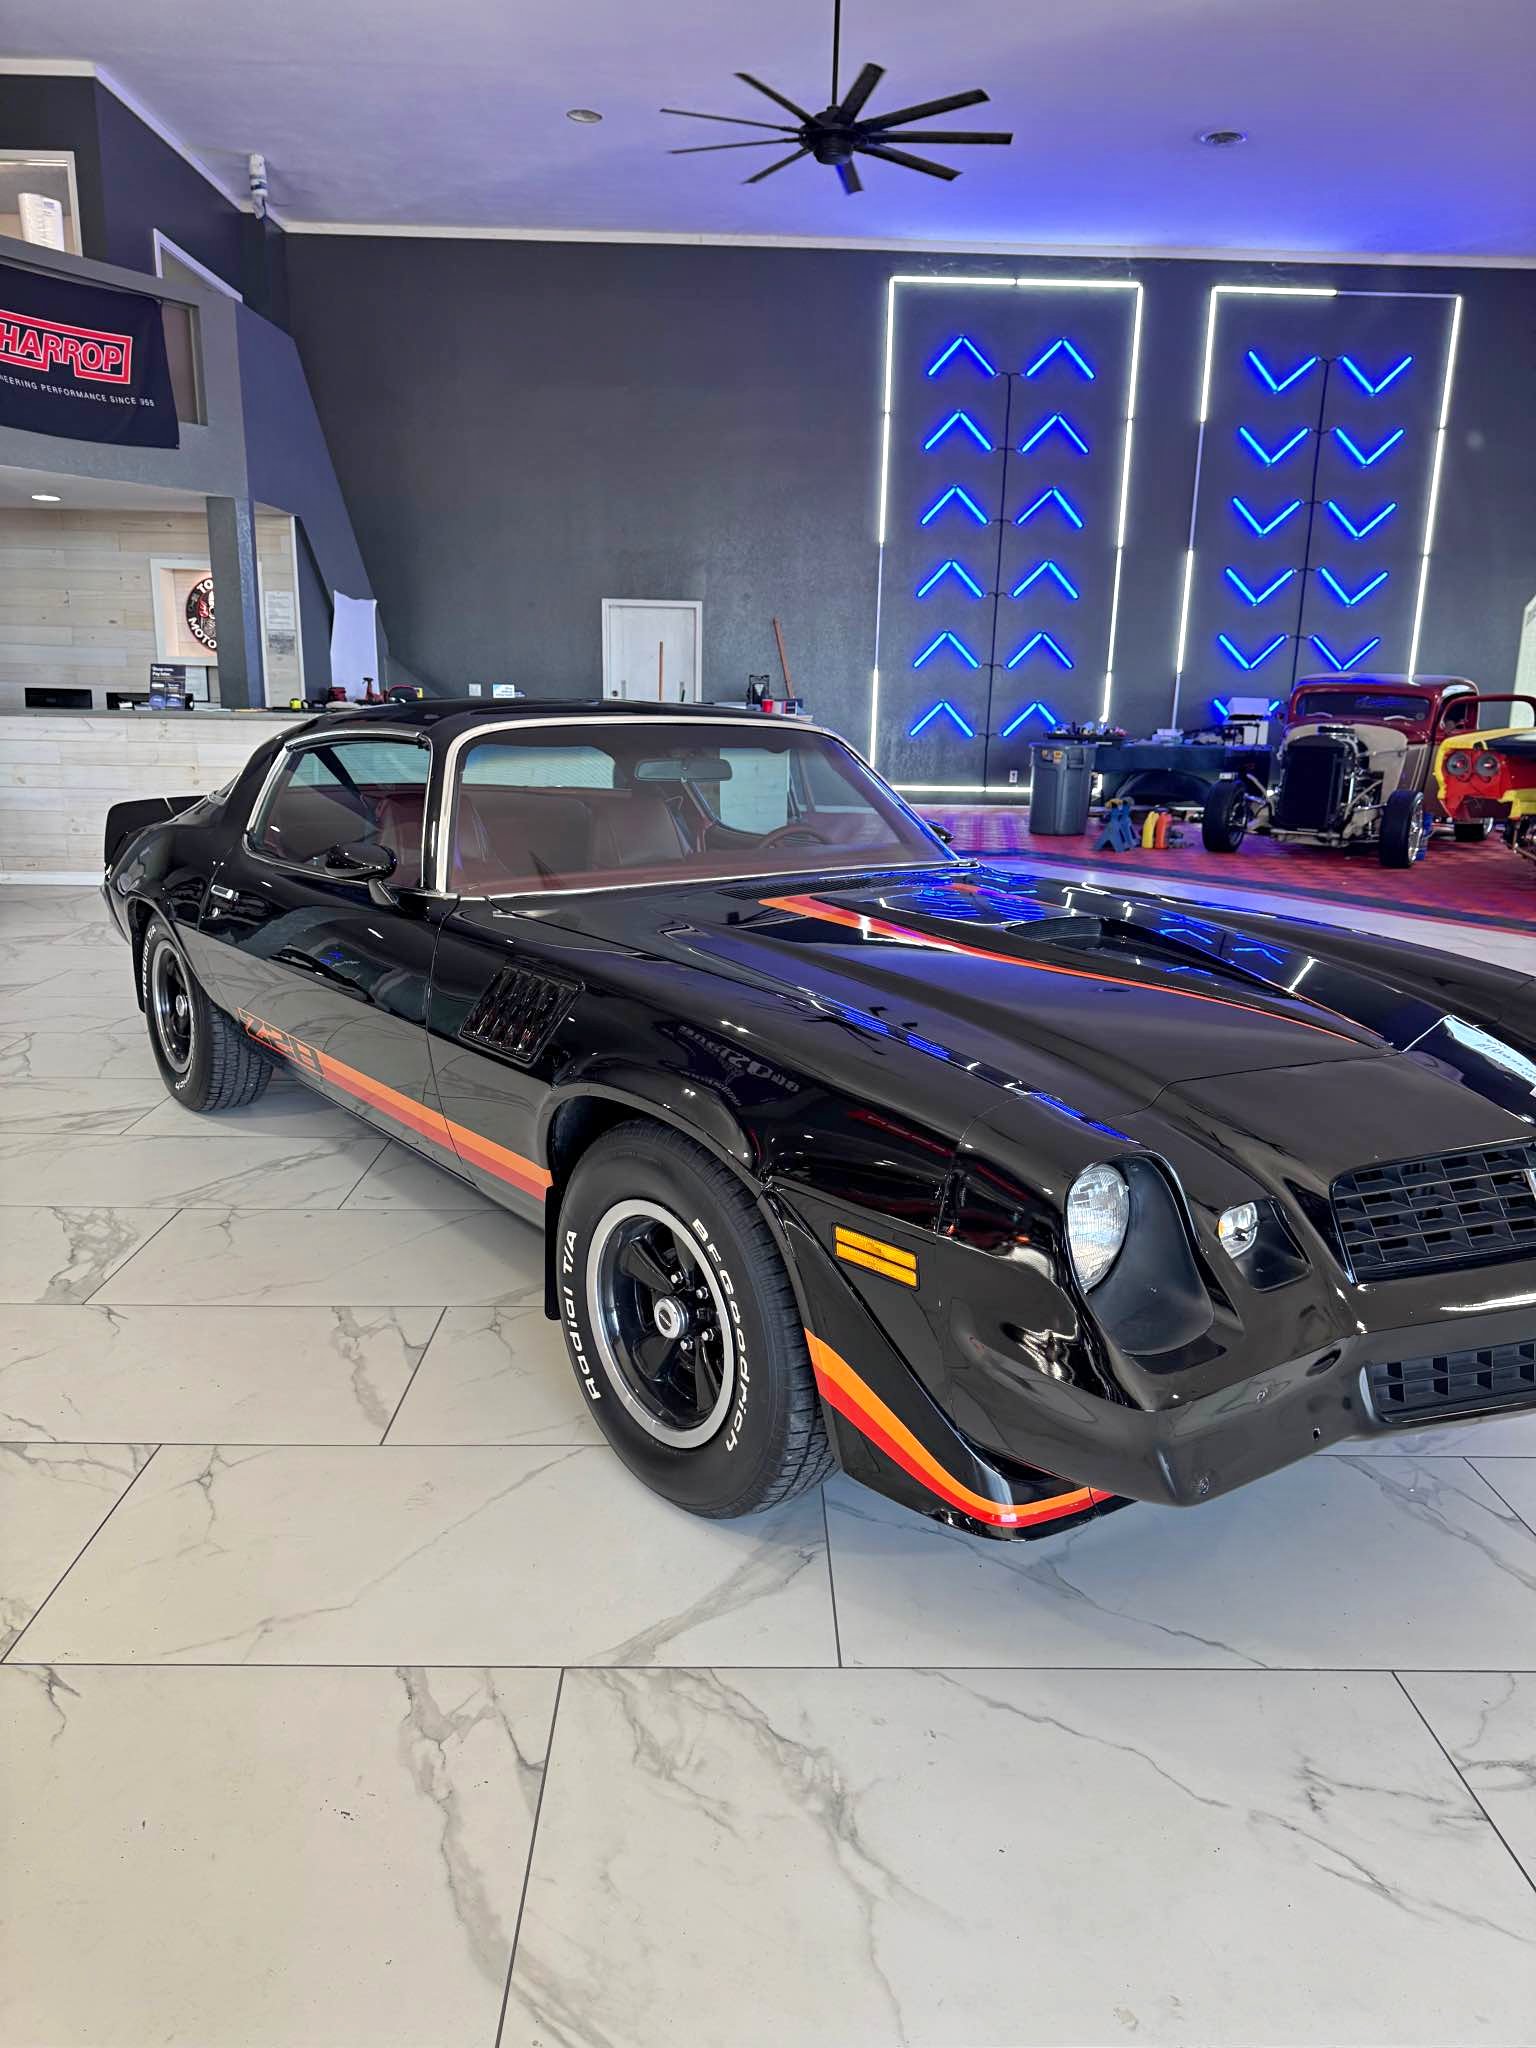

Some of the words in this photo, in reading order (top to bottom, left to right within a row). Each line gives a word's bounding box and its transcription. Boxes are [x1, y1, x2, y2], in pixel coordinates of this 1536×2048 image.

[0, 322, 122, 372] HARROP
[40, 383, 107, 402] PERFORMANCE
[109, 395, 137, 405] SINCE
[238, 1008, 325, 1077] Z28
[562, 1230, 578, 1275] T/A
[563, 1286, 601, 1400] Radial
